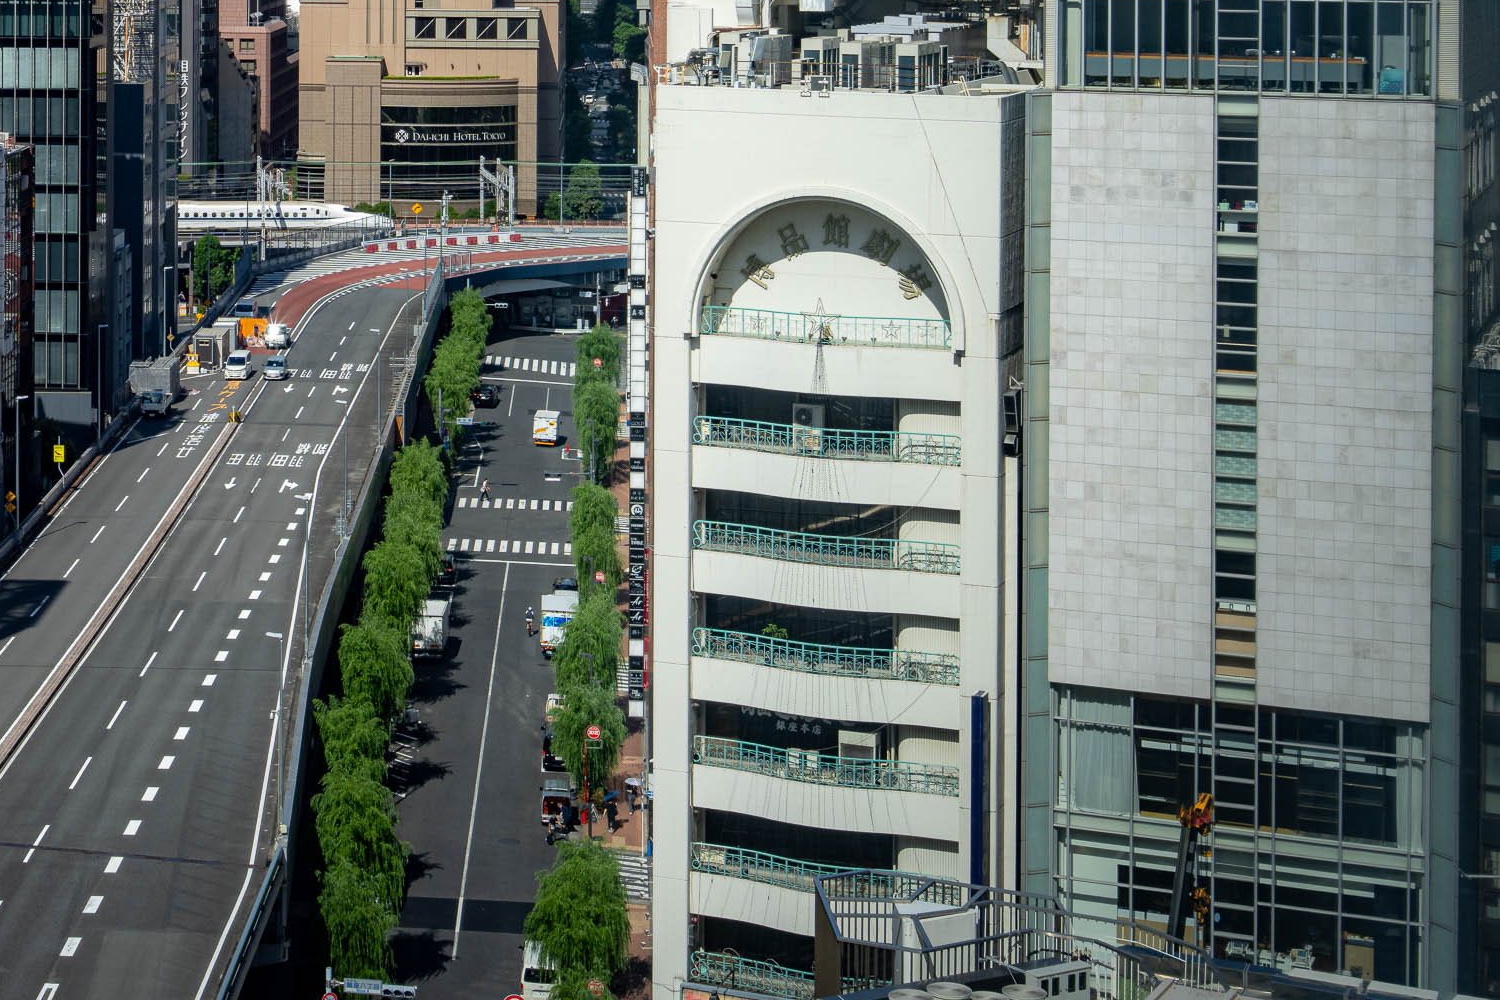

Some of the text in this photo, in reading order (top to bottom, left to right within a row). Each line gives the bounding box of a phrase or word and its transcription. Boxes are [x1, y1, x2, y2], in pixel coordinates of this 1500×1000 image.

[412, 131, 506, 142] DAI-ICHI HOTEL TOKYO
[226, 453, 262, 466] 羽田
[271, 454, 304, 467] 羽田
[776, 719, 822, 735] 銀座本店
